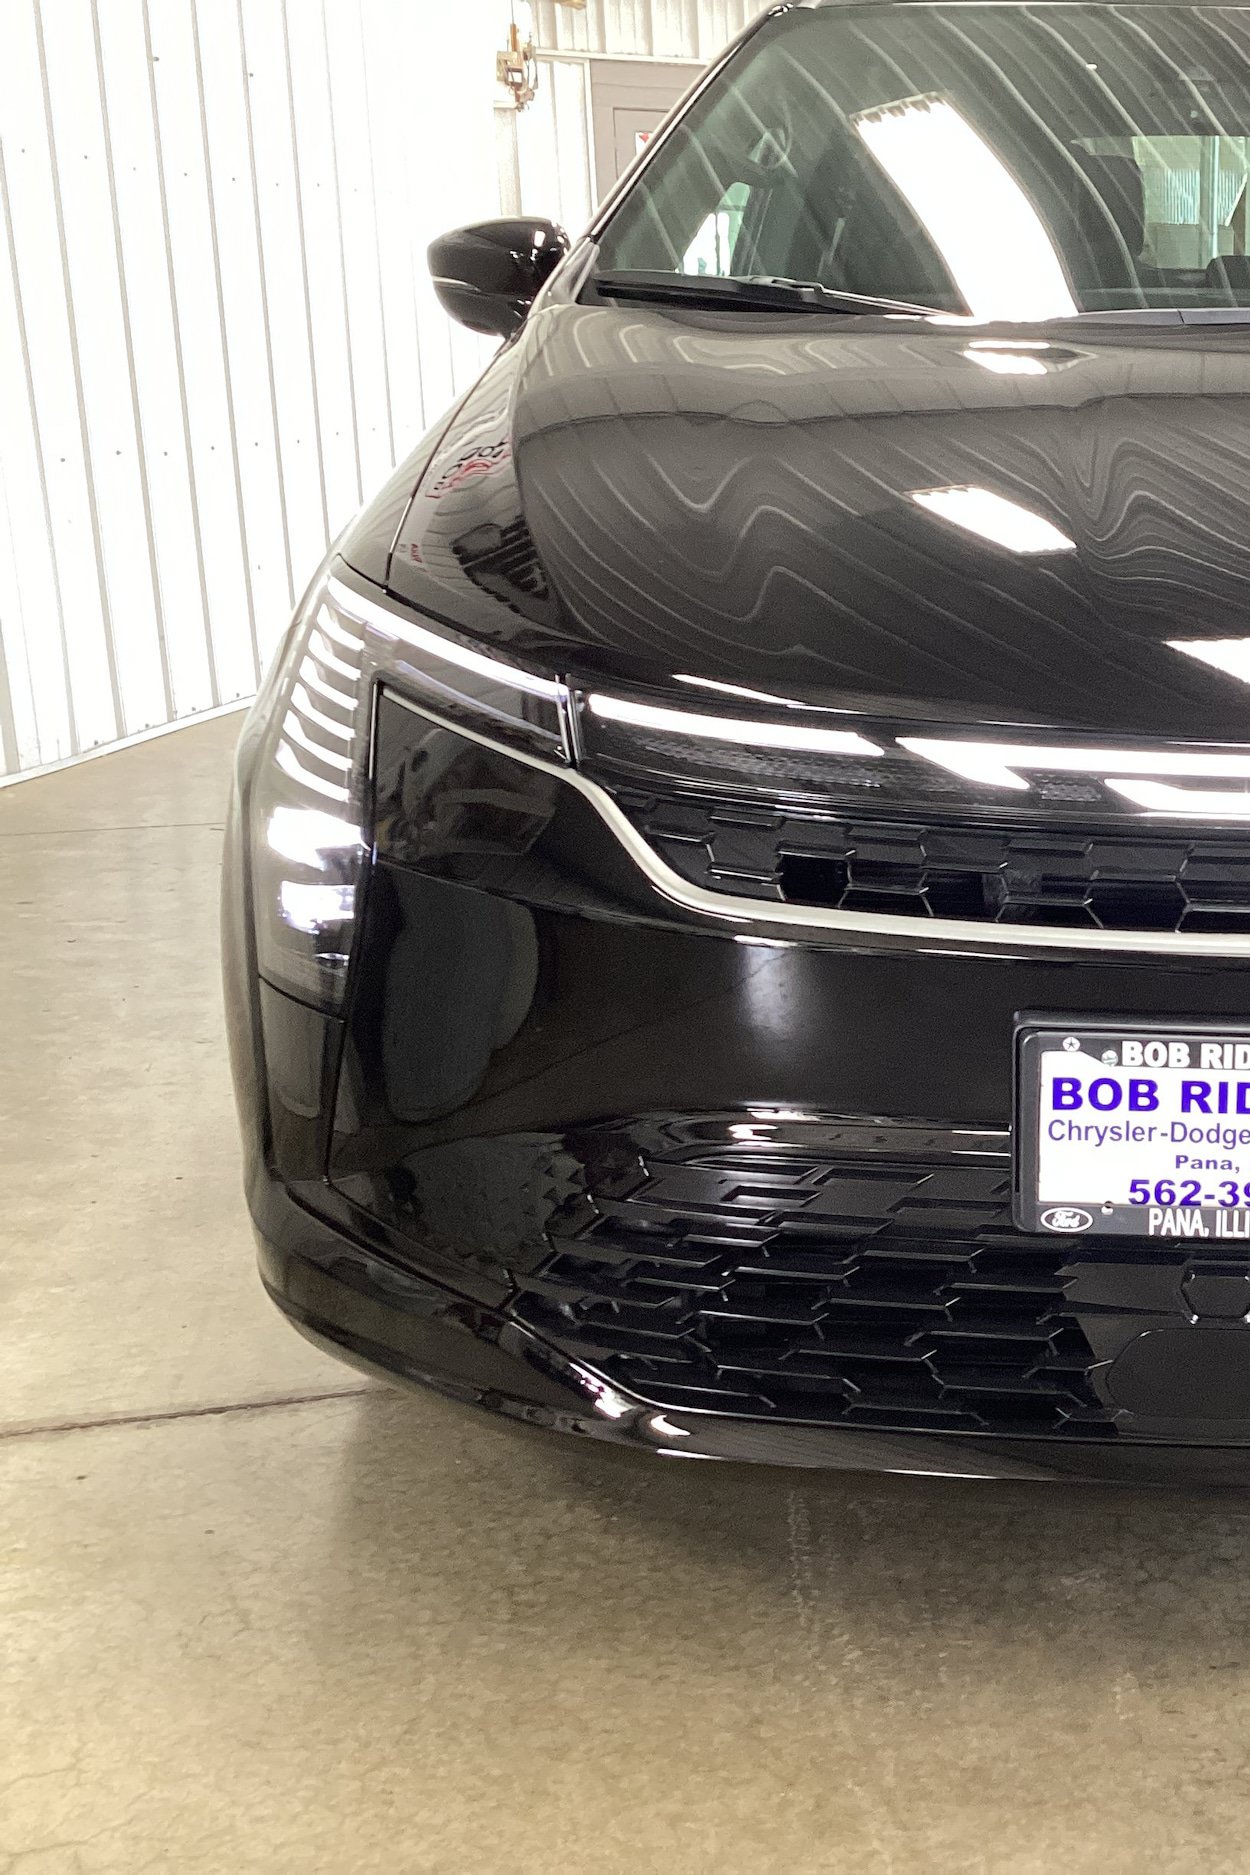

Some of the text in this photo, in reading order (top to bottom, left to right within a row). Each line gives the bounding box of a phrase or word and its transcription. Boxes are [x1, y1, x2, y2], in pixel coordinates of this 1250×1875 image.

[1121, 1040, 1190, 1068] BOB
[1052, 1077, 1159, 1111] BOB
[1175, 1154, 1240, 1173] Pana,
[1148, 1209, 1208, 1237] PANA,
